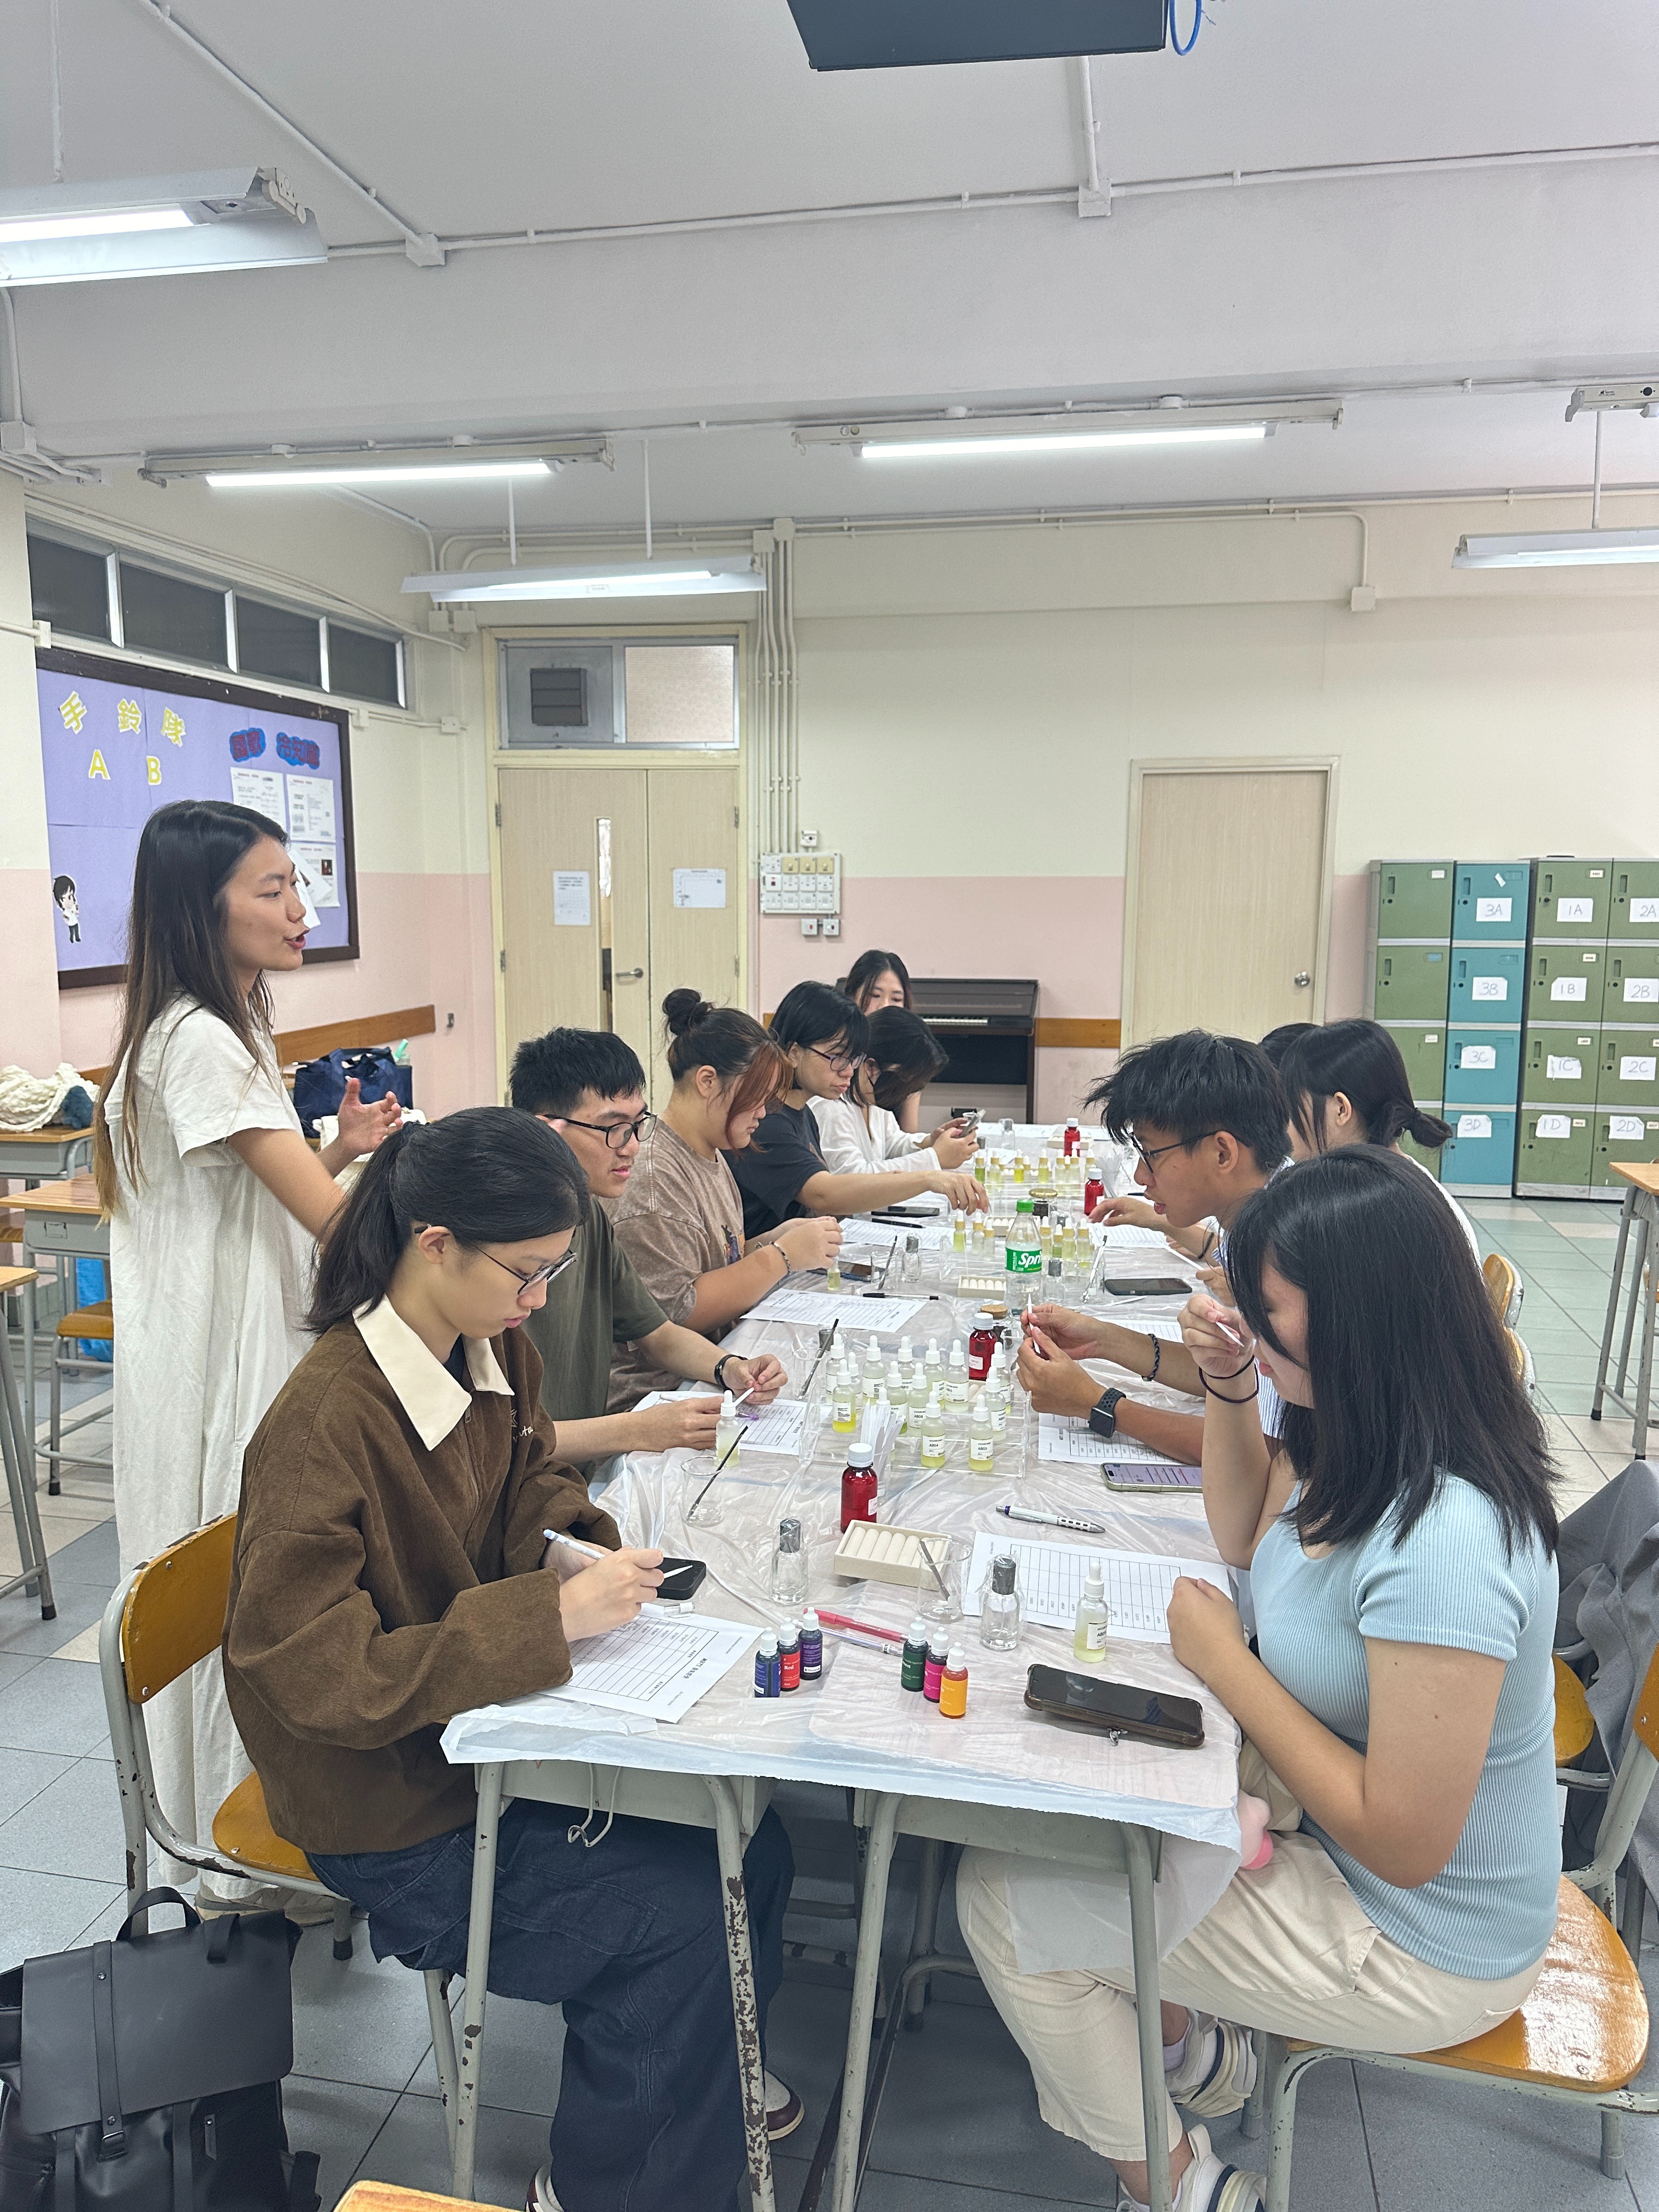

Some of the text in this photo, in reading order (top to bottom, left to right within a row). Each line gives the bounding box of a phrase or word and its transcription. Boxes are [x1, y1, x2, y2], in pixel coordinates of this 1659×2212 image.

[60, 692, 185, 745] 手鈴隊
[89, 751, 161, 784] A B
[1485, 904, 1503, 917] 3A
[1640, 905, 1657, 917] 2A
[1479, 982, 1498, 996] 3B
[1631, 984, 1650, 998] 2B
[1469, 1051, 1488, 1063] 3C
[1628, 1060, 1649, 1073] 2C
[1464, 1118, 1481, 1131] 3D
[1616, 1119, 1635, 1133] 2D
[1018, 1251, 1042, 1268] Spri
